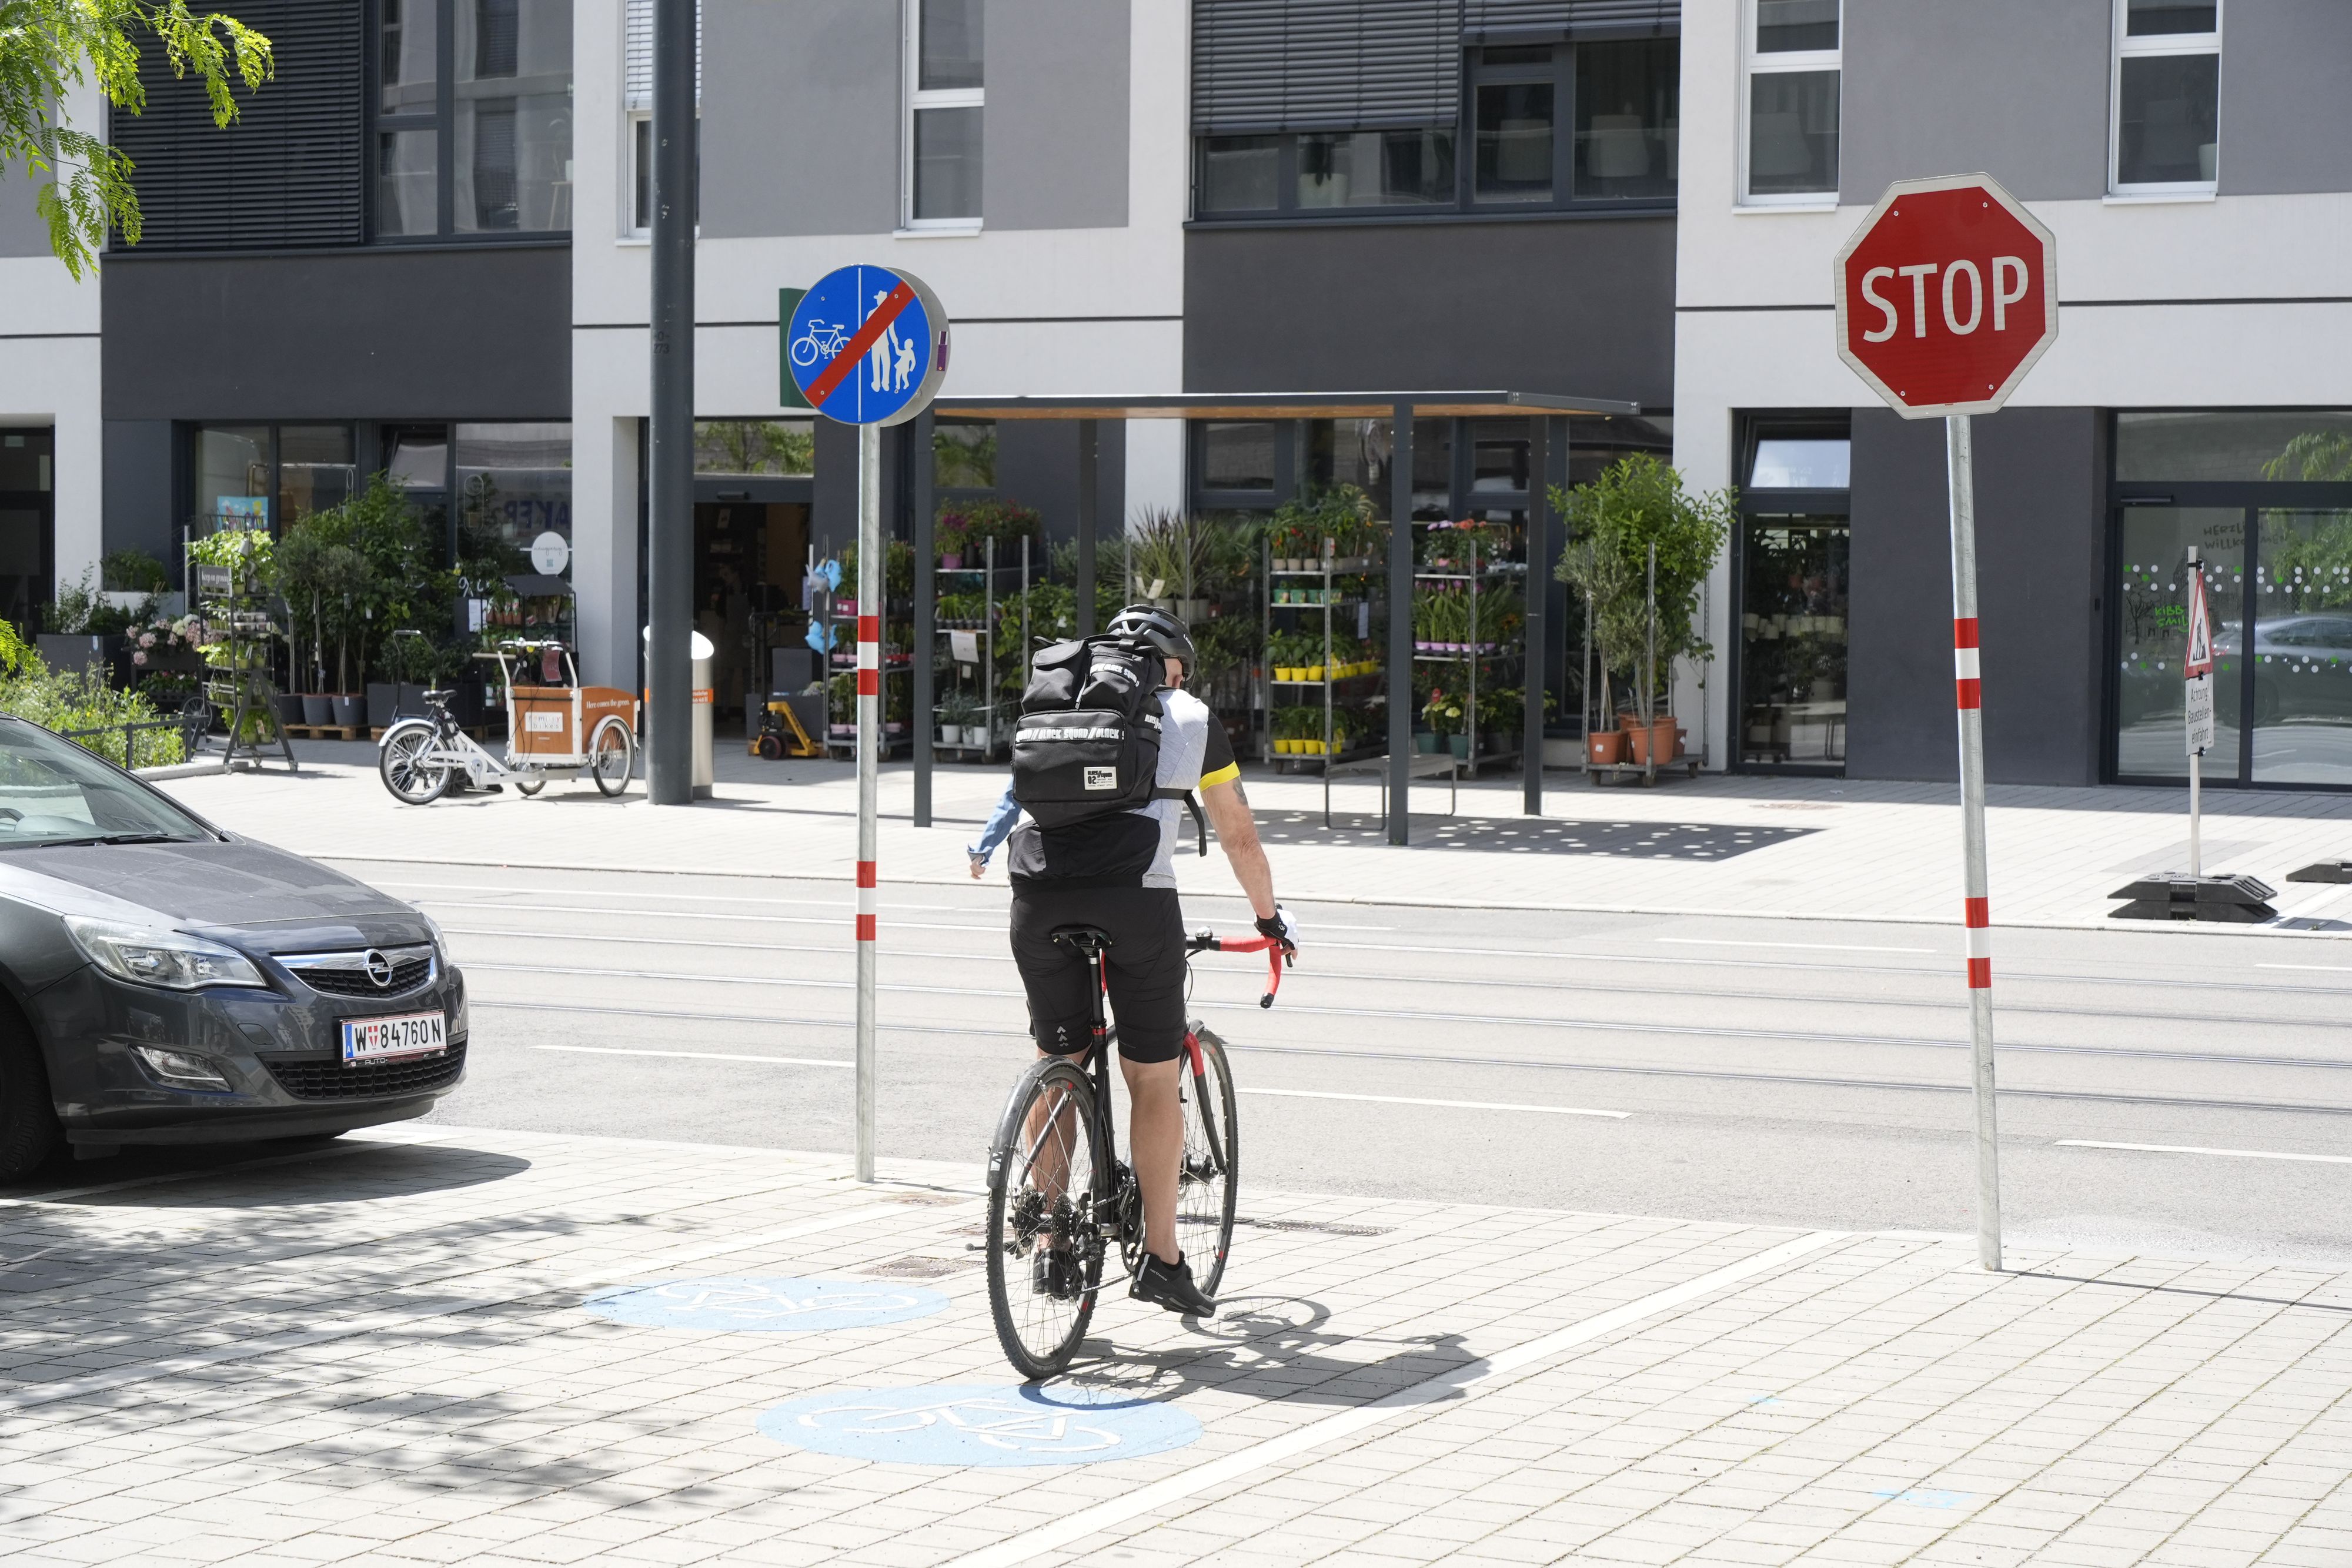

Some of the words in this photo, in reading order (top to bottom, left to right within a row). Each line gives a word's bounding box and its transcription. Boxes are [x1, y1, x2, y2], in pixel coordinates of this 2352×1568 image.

[1861, 255, 2029, 343] STOP
[2190, 683, 2209, 703] Achtung!
[2188, 706, 2211, 725] Baustellen-
[2191, 726, 2209, 744] einfahrt
[1088, 775, 1097, 784] 02
[355, 1026, 366, 1052] W
